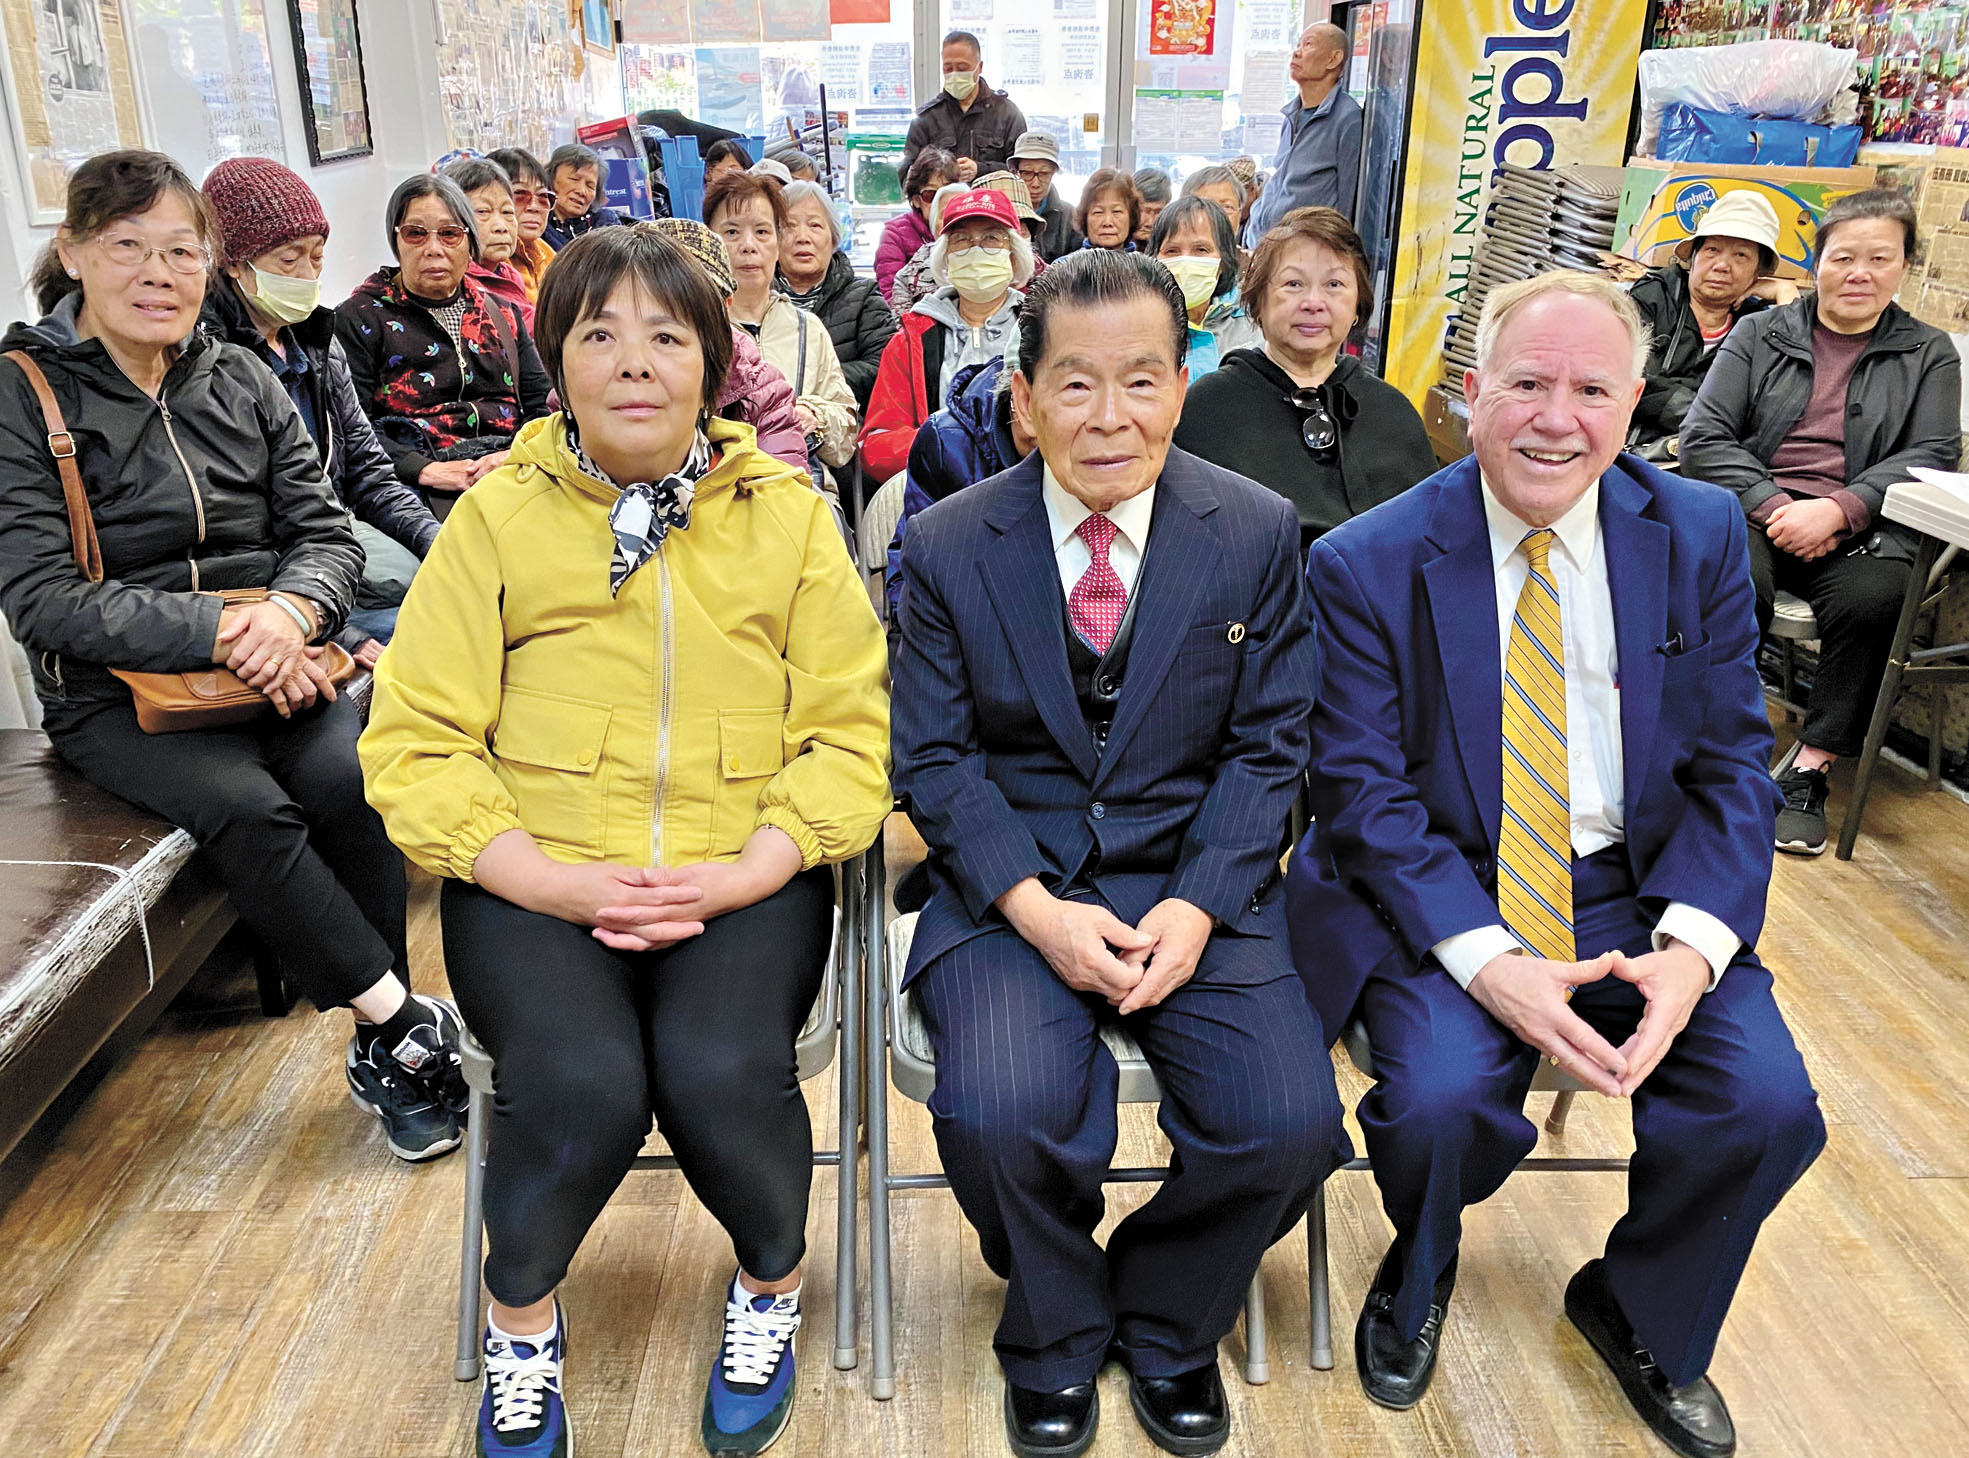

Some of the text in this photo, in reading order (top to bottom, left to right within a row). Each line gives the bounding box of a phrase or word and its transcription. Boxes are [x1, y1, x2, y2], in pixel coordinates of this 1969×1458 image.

[1444, 64, 1496, 305] ALL NATURAL
[1674, 188, 1716, 213] Chiquita
